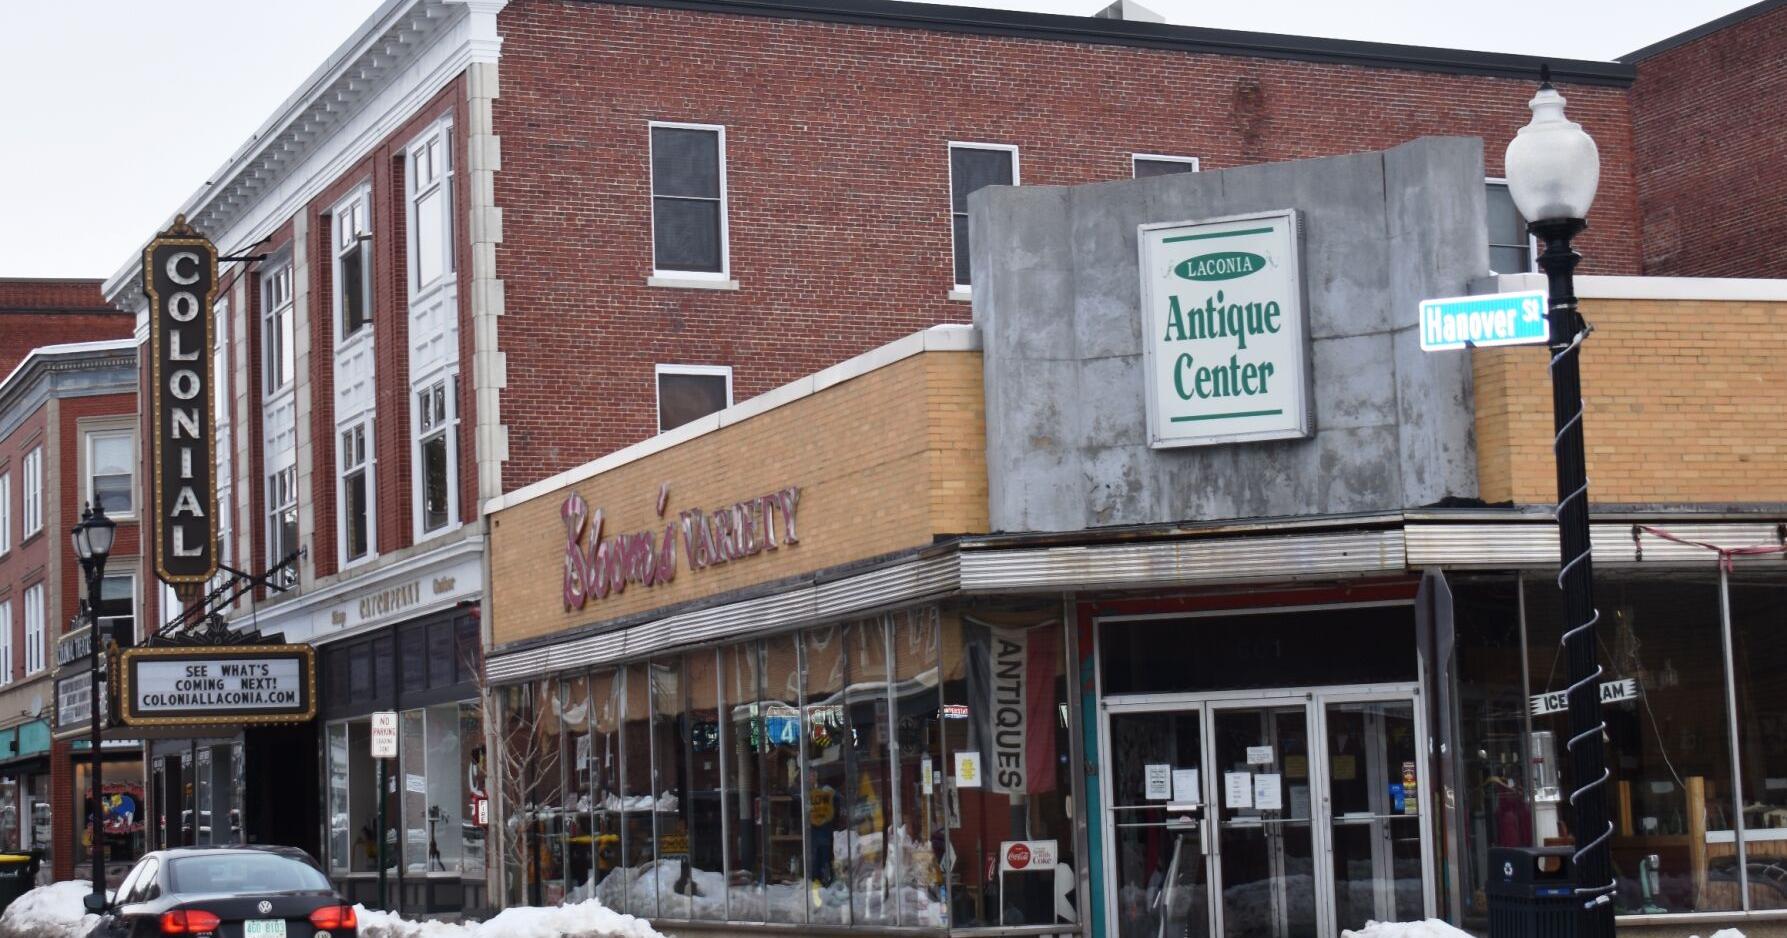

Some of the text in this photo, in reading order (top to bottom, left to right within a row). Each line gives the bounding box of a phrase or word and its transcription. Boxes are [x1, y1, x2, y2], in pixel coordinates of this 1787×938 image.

[1187, 256, 1253, 278] LACONIA
[1164, 290, 1282, 350] Antique
[1426, 299, 1540, 343] Hanover St
[1174, 352, 1275, 401] Center
[165, 251, 205, 558] COLONIAL
[679, 485, 801, 571] VARIETY
[185, 664, 269, 678] SEE WHAT'S
[175, 677, 277, 691] COMING NEXT!
[143, 690, 295, 707] COLONIALLACONIA.COM
[1544, 693, 1568, 711] ICE
[380, 717, 390, 726] NO
[995, 638, 1023, 789] ANTIQUES
[373, 728, 396, 737] PARKING
